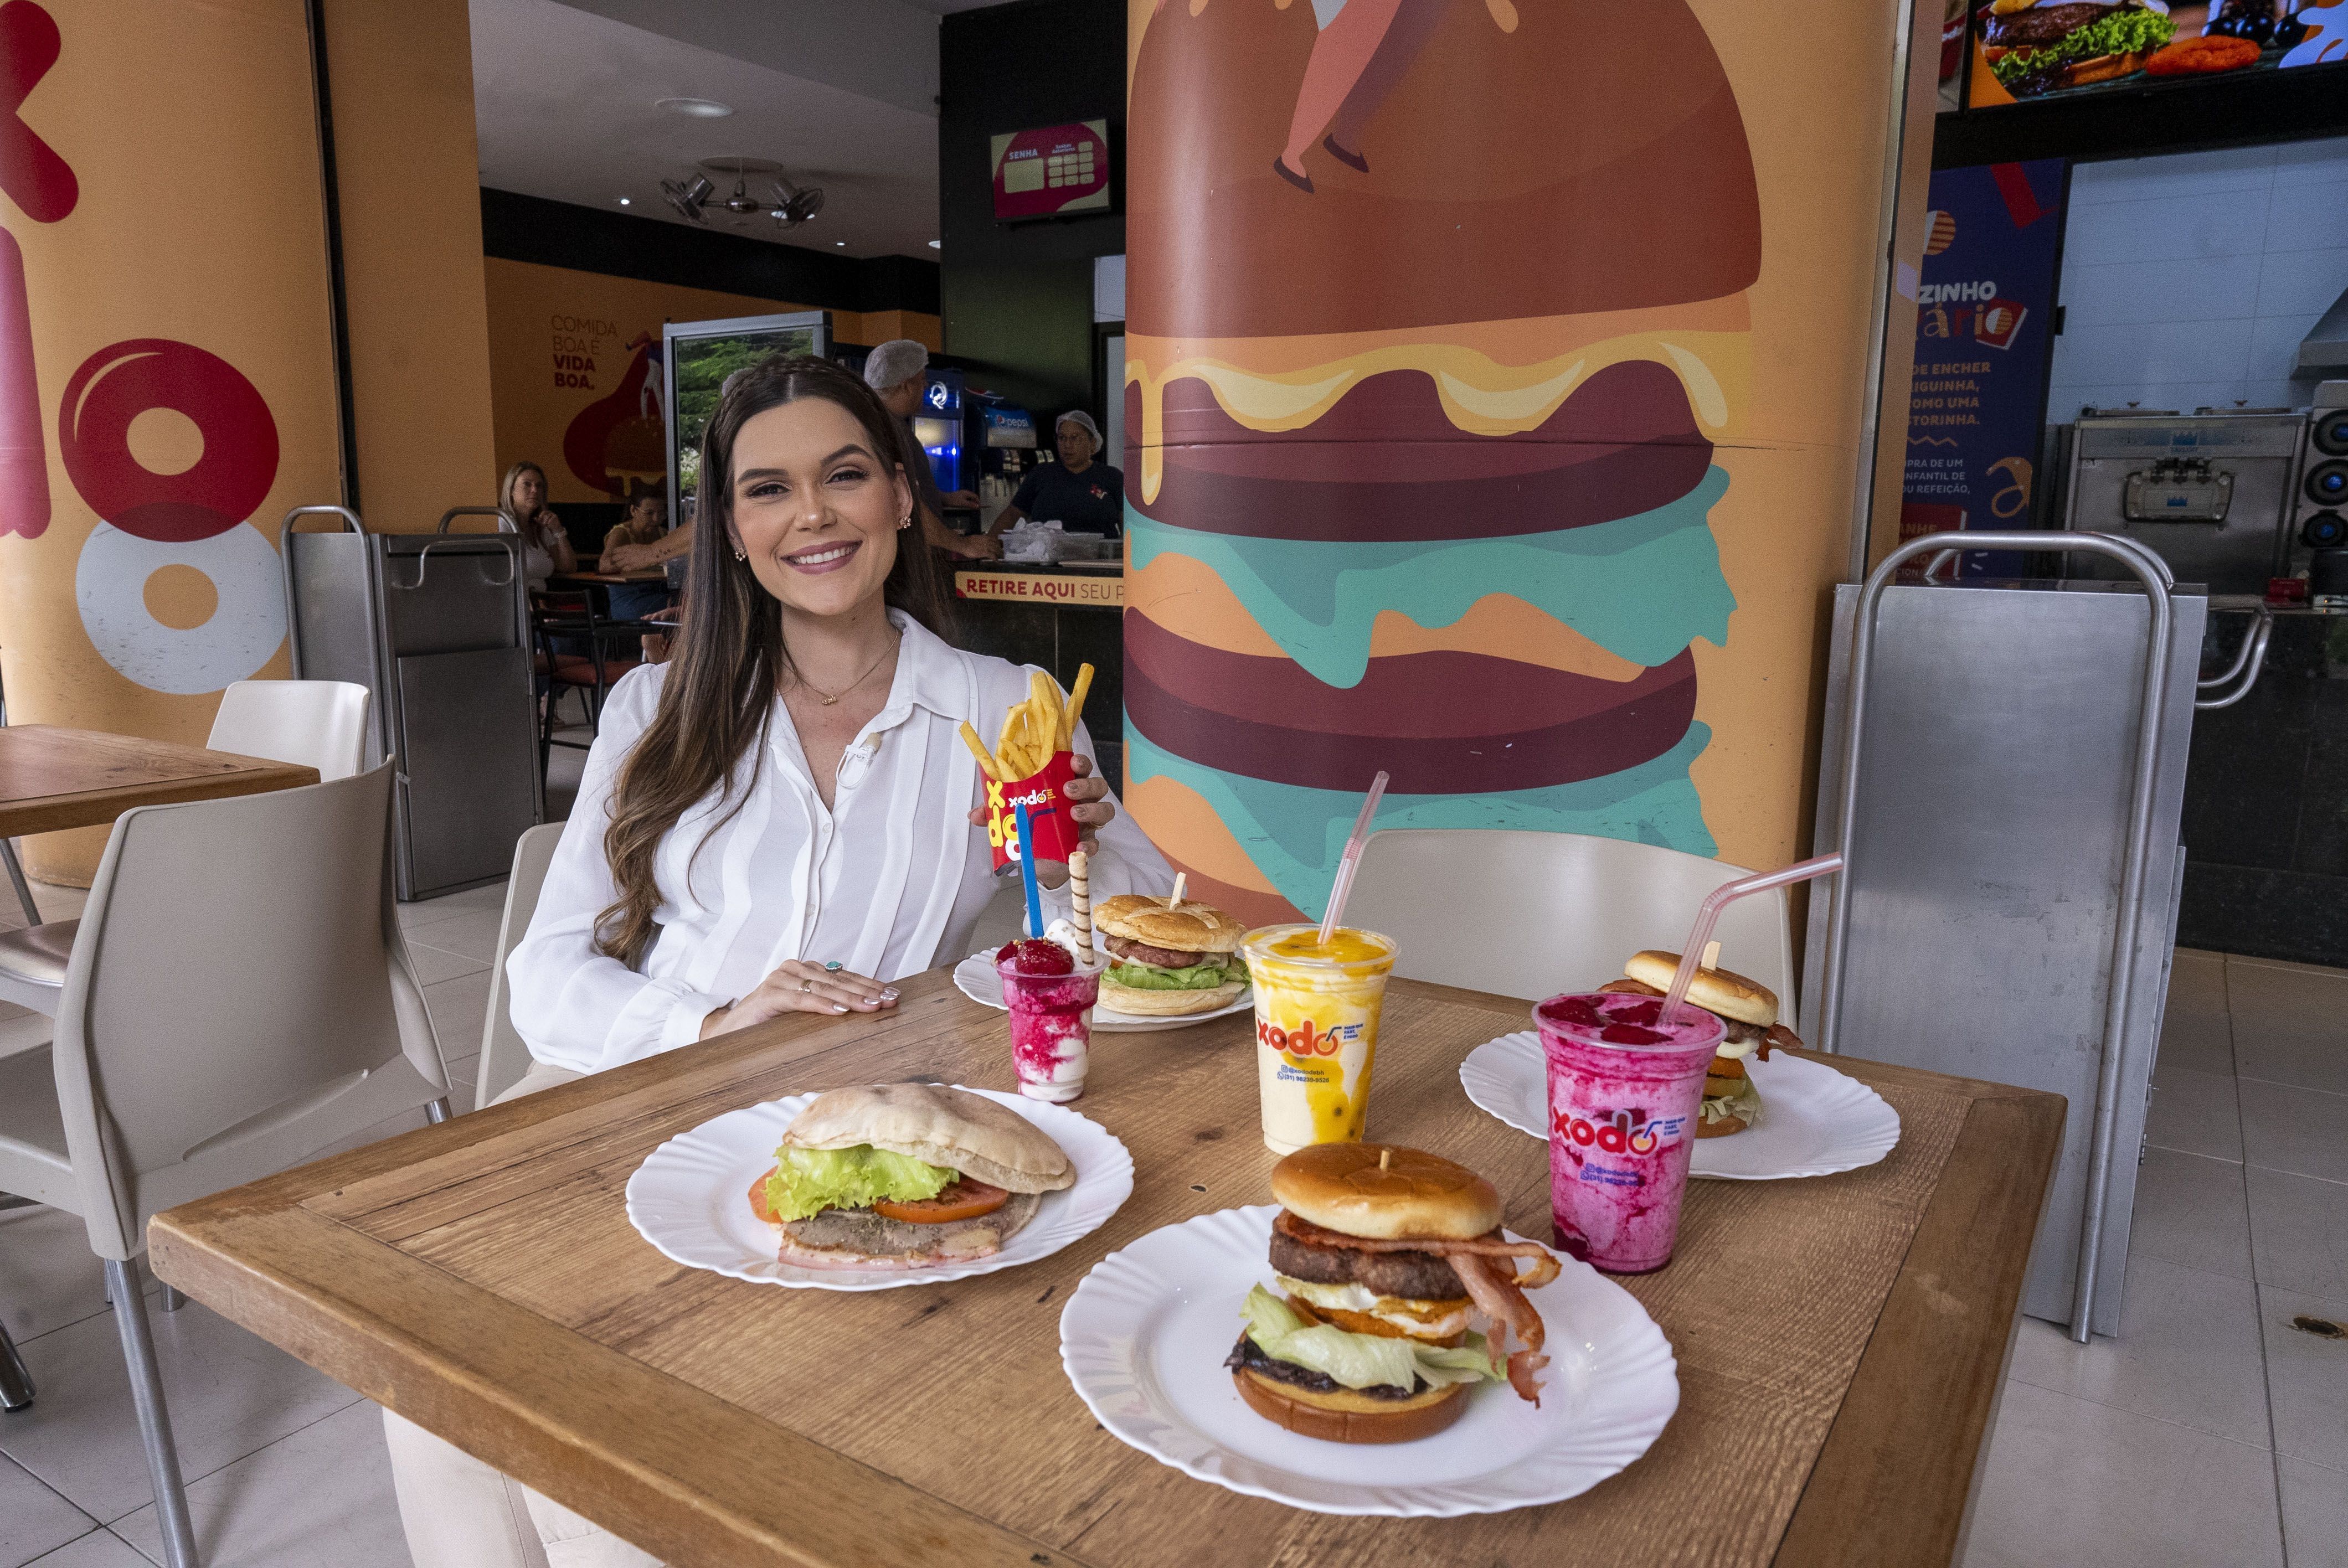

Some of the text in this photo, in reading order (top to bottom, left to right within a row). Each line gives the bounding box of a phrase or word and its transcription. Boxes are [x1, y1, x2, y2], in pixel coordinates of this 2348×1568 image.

[1009, 148, 1038, 159] SENHA
[552, 315, 619, 337] COMIDA
[553, 336, 588, 354] BOA
[553, 354, 596, 372] VIDA
[1932, 362, 1991, 375] ENCHER
[554, 372, 595, 390] BOA.
[1911, 379, 1979, 393] IGUINHA,
[1947, 397, 1980, 409] UMA
[1006, 417, 1029, 429] pepsi
[1930, 459, 1944, 467] DE
[1946, 458, 1964, 467] UM
[1951, 472, 1966, 480] DE
[1917, 483, 1971, 494] REFEIÇÃO,
[966, 578, 1027, 596] RETIRE
[1032, 582, 1075, 600] AQUI
[1080, 584, 1111, 599] SEU
[1284, 1074, 1295, 1082] (31)
